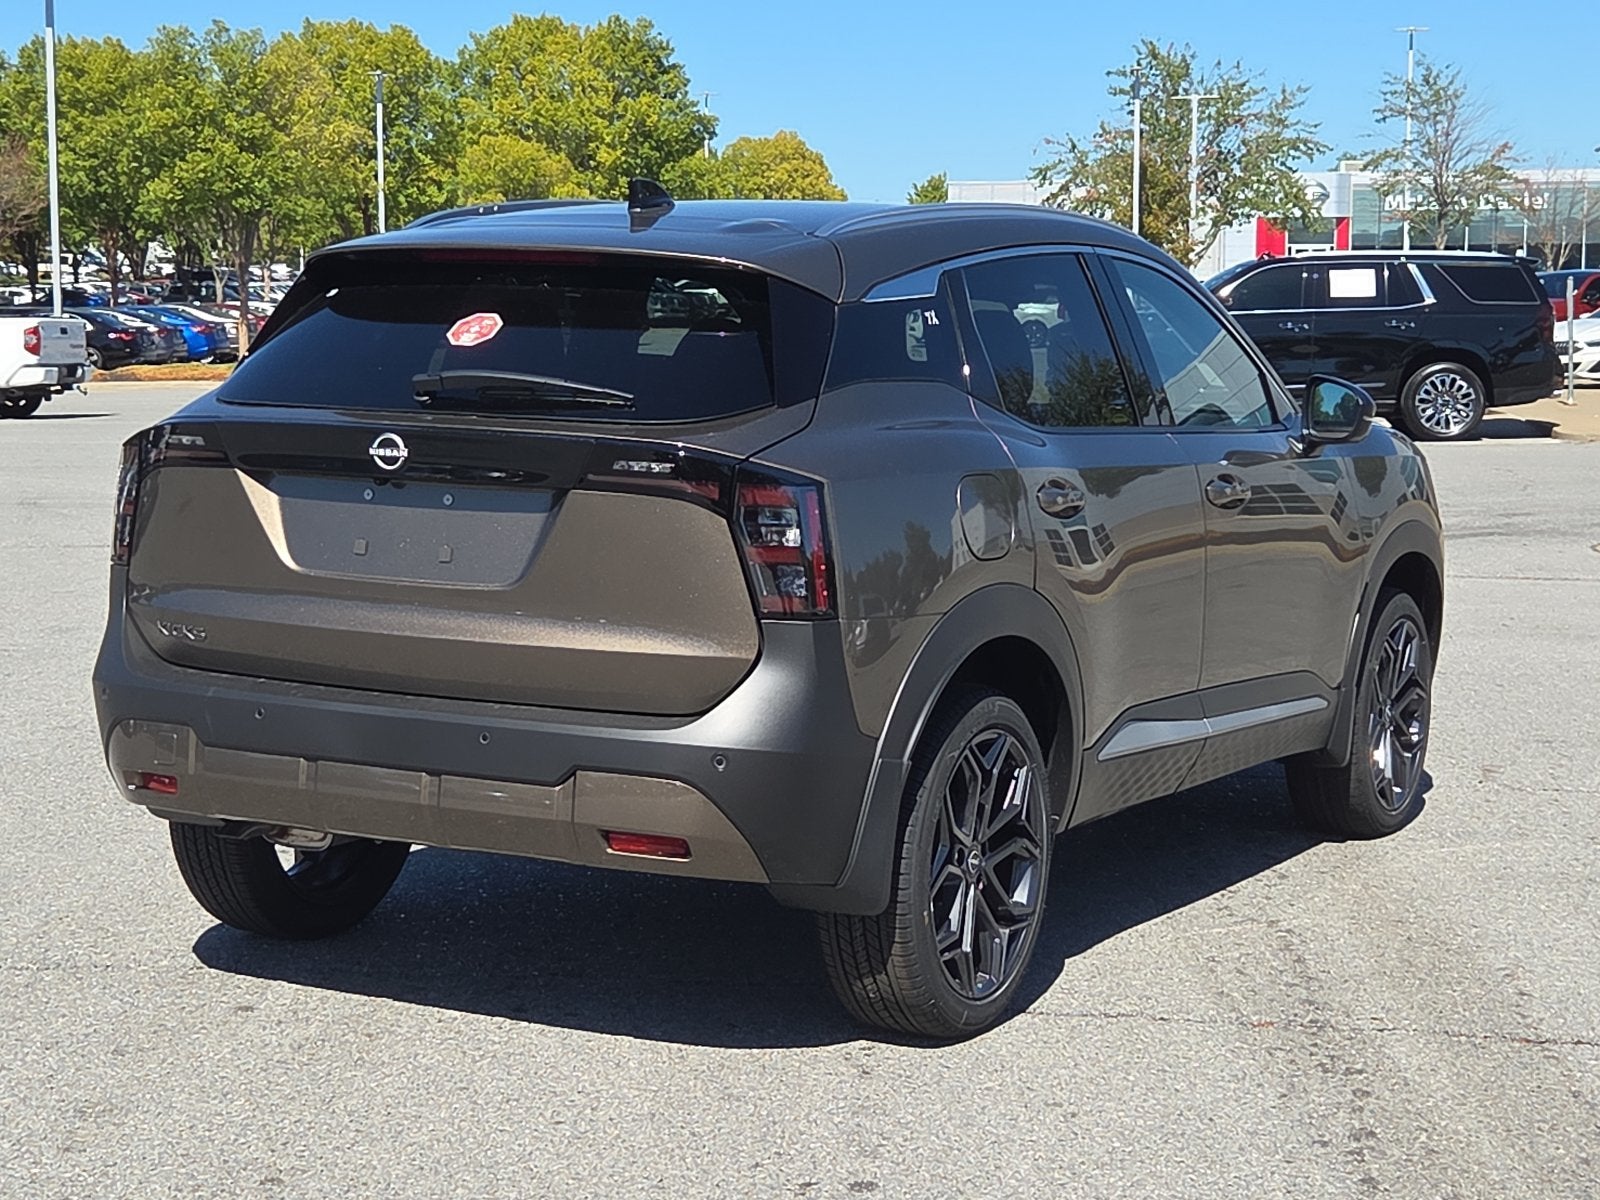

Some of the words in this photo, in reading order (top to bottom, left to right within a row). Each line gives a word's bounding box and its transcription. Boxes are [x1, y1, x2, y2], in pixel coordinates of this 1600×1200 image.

[1384, 190, 1470, 211] McLa
[1477, 190, 1550, 210] Daiel
[368, 447, 408, 457] NISSAN
